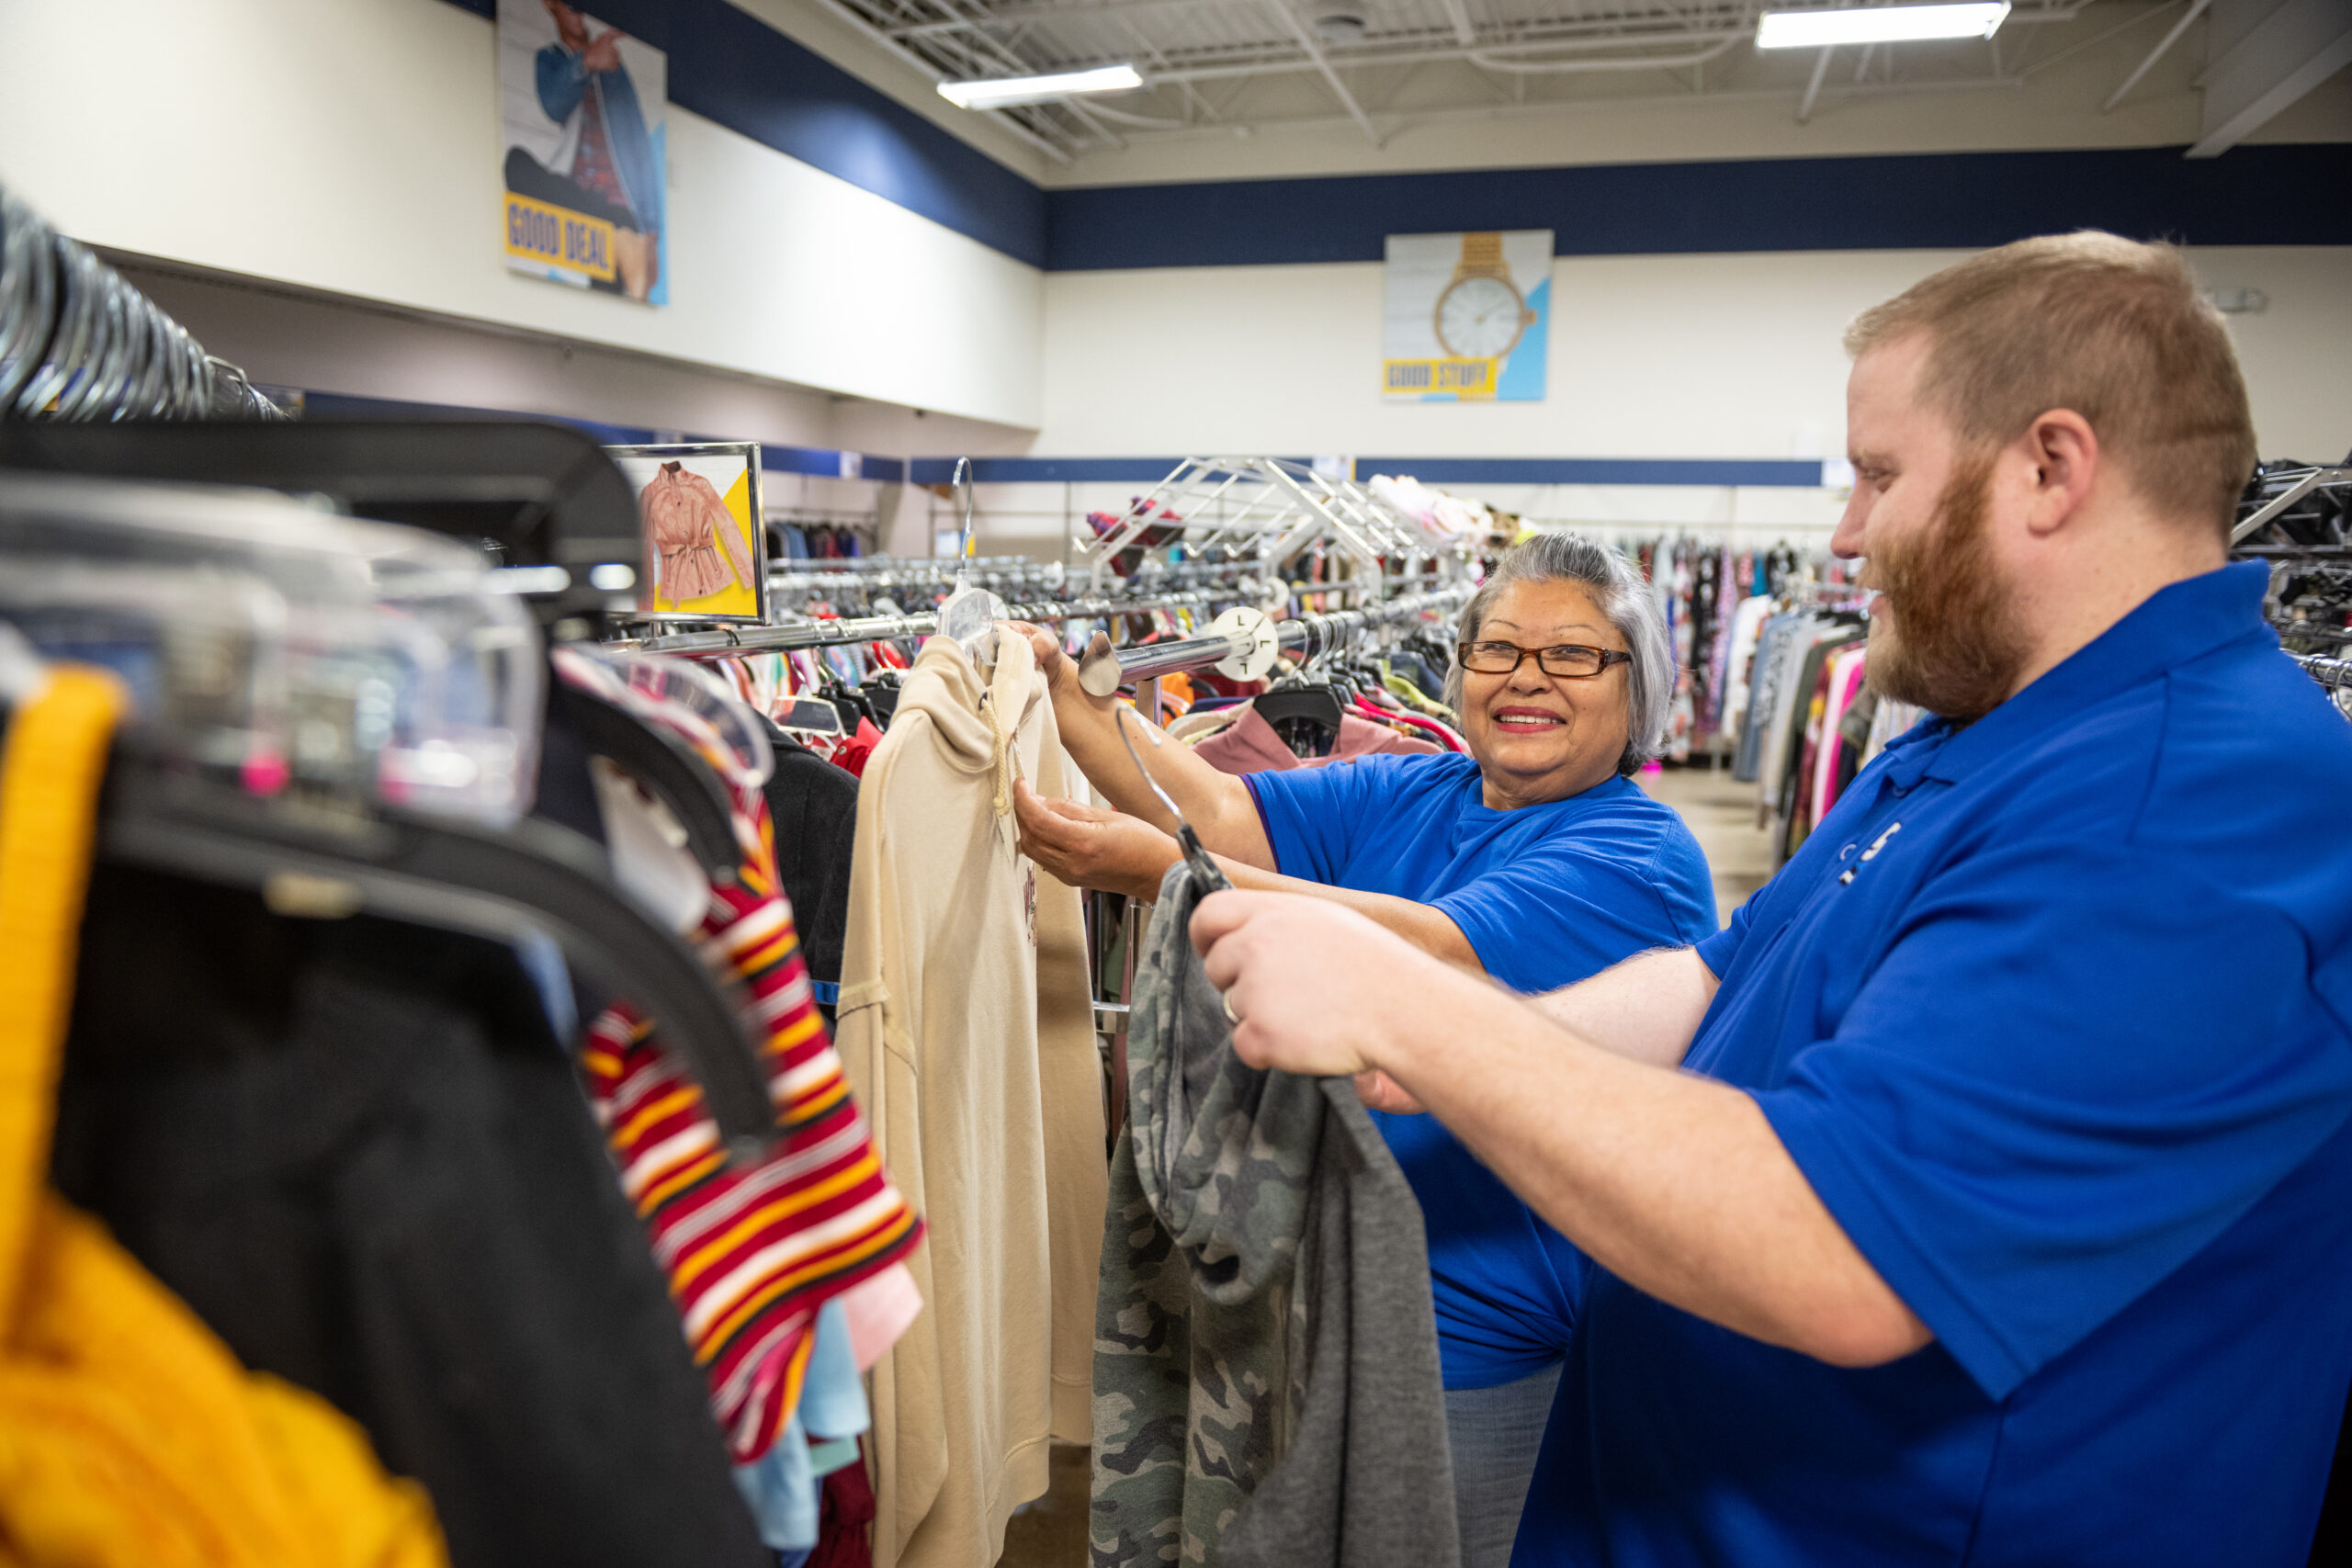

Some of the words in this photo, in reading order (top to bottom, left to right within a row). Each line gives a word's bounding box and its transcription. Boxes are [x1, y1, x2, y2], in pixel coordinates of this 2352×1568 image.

[508, 203, 560, 256] GOOD
[565, 220, 610, 271] DEAL
[1388, 364, 1431, 388] GOOD
[1238, 615, 1245, 626] L
[1239, 663, 1248, 674] L
